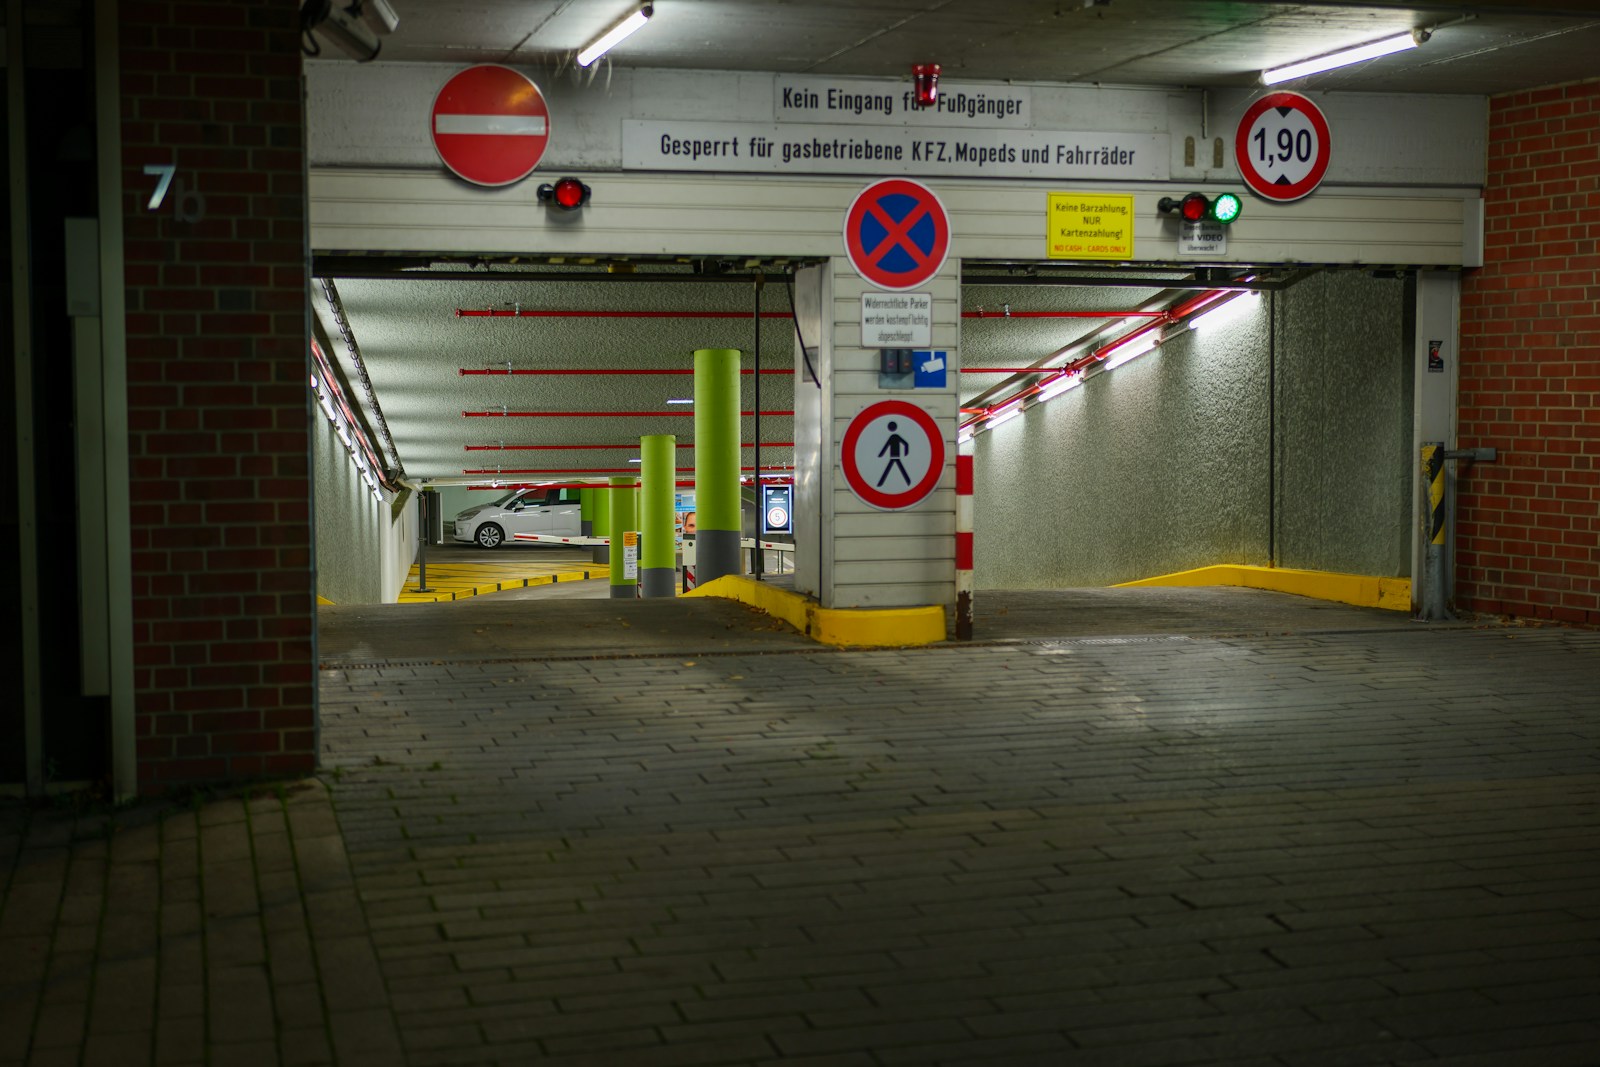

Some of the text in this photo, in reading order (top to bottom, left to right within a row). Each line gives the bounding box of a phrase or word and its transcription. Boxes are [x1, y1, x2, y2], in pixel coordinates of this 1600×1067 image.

[783, 87, 819, 110] Kein
[827, 88, 893, 116] Eingang
[937, 92, 1023, 120] Fußgänger
[661, 133, 739, 161] Gesperrt
[750, 137, 775, 159] für
[782, 138, 903, 164] gasbetriebene
[1022, 144, 1049, 164] und
[1056, 145, 1136, 166] Fahrräder
[1254, 127, 1312, 168] 1,90
[1055, 203, 1079, 213] Keine
[1083, 216, 1101, 225] NUR
[1060, 228, 1123, 241] Kartenzahlung!
[1197, 234, 1223, 242] VIDEO
[1054, 244, 1064, 252] NO
[1064, 244, 1083, 253] CASH
[1087, 245, 1109, 253] CARDS
[1109, 246, 1127, 254] ONLY
